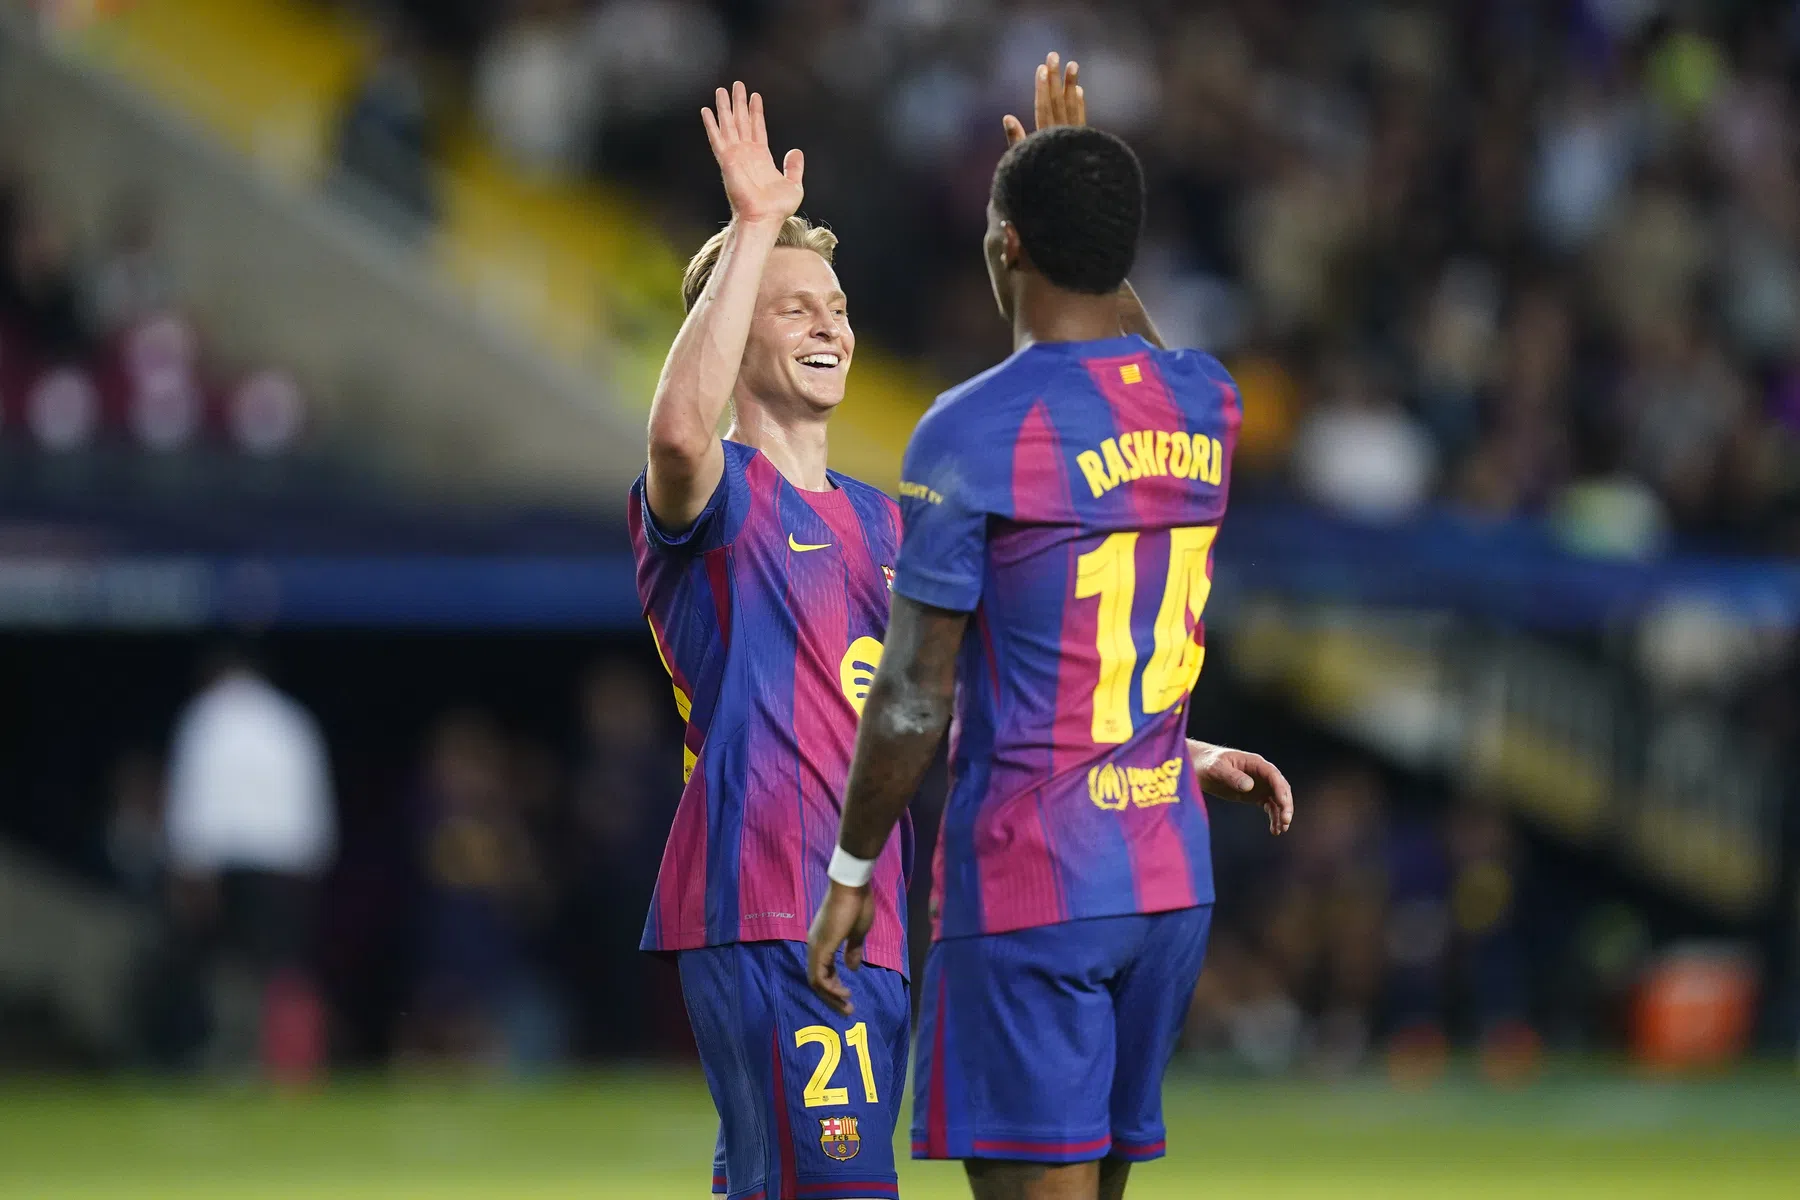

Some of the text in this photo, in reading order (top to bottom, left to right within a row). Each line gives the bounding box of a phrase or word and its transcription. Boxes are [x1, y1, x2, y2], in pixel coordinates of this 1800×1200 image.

[1076, 430, 1222, 498] RASHFORD
[1075, 526, 1218, 743] 14
[795, 1022, 879, 1107] 21
